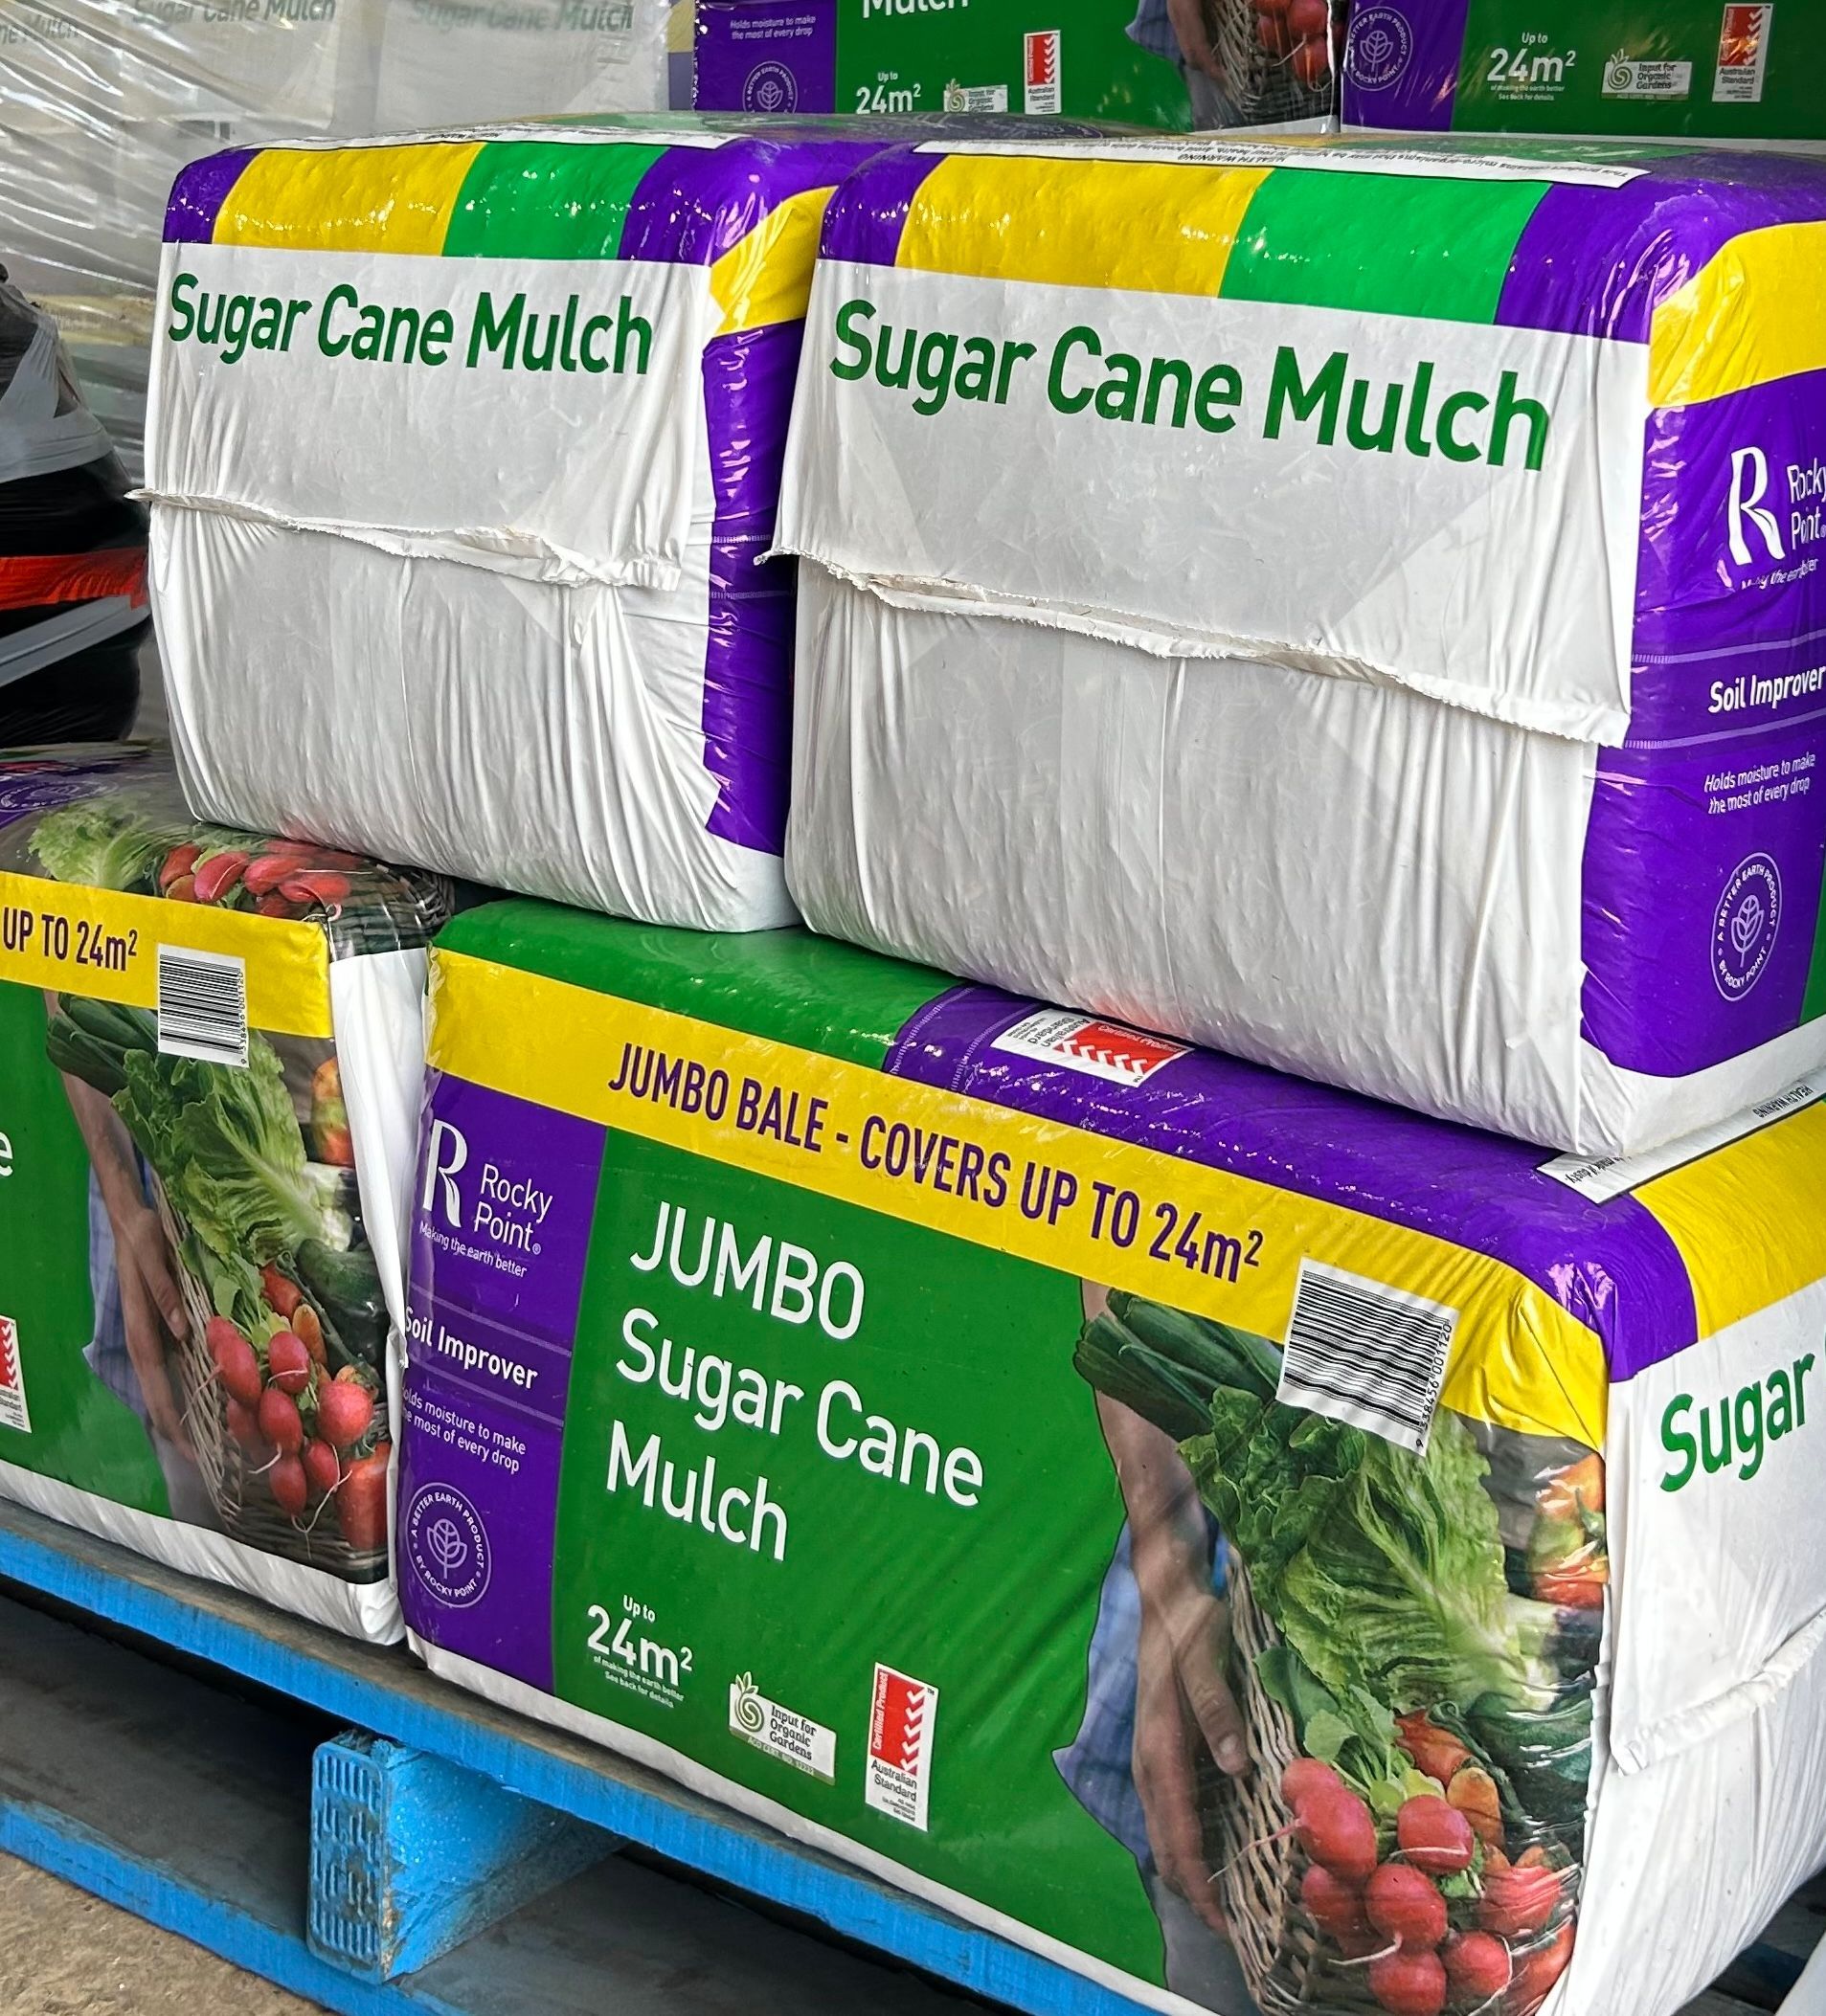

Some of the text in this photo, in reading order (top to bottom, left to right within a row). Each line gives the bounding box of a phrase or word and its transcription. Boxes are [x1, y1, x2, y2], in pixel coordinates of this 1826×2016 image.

[732, 27, 813, 39] the most of every drop
[785, 17, 794, 26] to
[795, 15, 816, 25] make
[1522, 32, 1548, 46] Up to
[878, 71, 898, 83] Up to
[1487, 48, 1577, 82] 24m²
[1635, 81, 1673, 90] Gardens
[1637, 72, 1672, 82] Organic
[1638, 62, 1678, 73] Input for
[1397, 154, 1499, 168] micro-organisms
[1602, 168, 1630, 179] This
[167, 272, 652, 375] Sugar Cane Mulch
[829, 299, 1551, 472] Sugar Cane Mulch
[1707, 665, 1826, 713] Soil Improver
[1703, 751, 1816, 793] Holds moisture to make
[1708, 775, 1811, 815] the most of every drop
[1718, 878, 1743, 928] BETTER
[1741, 863, 1766, 882] EARTH
[1763, 868, 1777, 927] PRODUCT
[3, 907, 138, 972] UP TO 24m²
[1724, 973, 1746, 989] ROCKY
[1746, 946, 1767, 982] POINT
[1027, 1016, 1075, 1045] Standard
[1040, 1018, 1092, 1048] Australian
[1751, 1097, 1789, 1119] WARNING
[608, 1042, 1267, 1285] JUMBO BALE - COVERS UP TO 24m²
[481, 1163, 553, 1224] Rocky
[419, 1220, 528, 1278] Making the earth better
[629, 1199, 866, 1340] JUMBO
[406, 1306, 538, 1389] Soil Improver
[1415, 1438, 1425, 1448] 9
[1431, 1323, 1453, 1376] 001120
[403, 1387, 527, 1456] olds moisture to make
[616, 1307, 984, 1508] Sugar Cane
[1659, 1353, 1815, 1492] Sugar
[414, 1417, 521, 1475] most of every drop
[606, 1419, 789, 1562] Mulch
[411, 1491, 485, 1569] A BETTER EARTH PRODUCT
[416, 1555, 478, 1598] BY ROCKY POINT
[622, 1594, 657, 1624] Up to
[587, 1603, 693, 1688] 24m²
[619, 1676, 638, 1691] back
[637, 1684, 649, 1696] for
[649, 1691, 675, 1709] details
[662, 1684, 685, 1702] better
[872, 1671, 889, 1751] Certified Product
[770, 1717, 812, 1748] Organic
[771, 1704, 818, 1737] Input for
[769, 1730, 812, 1761] Gardens
[870, 1758, 918, 1790] Australian
[874, 1773, 917, 1803] Standard
